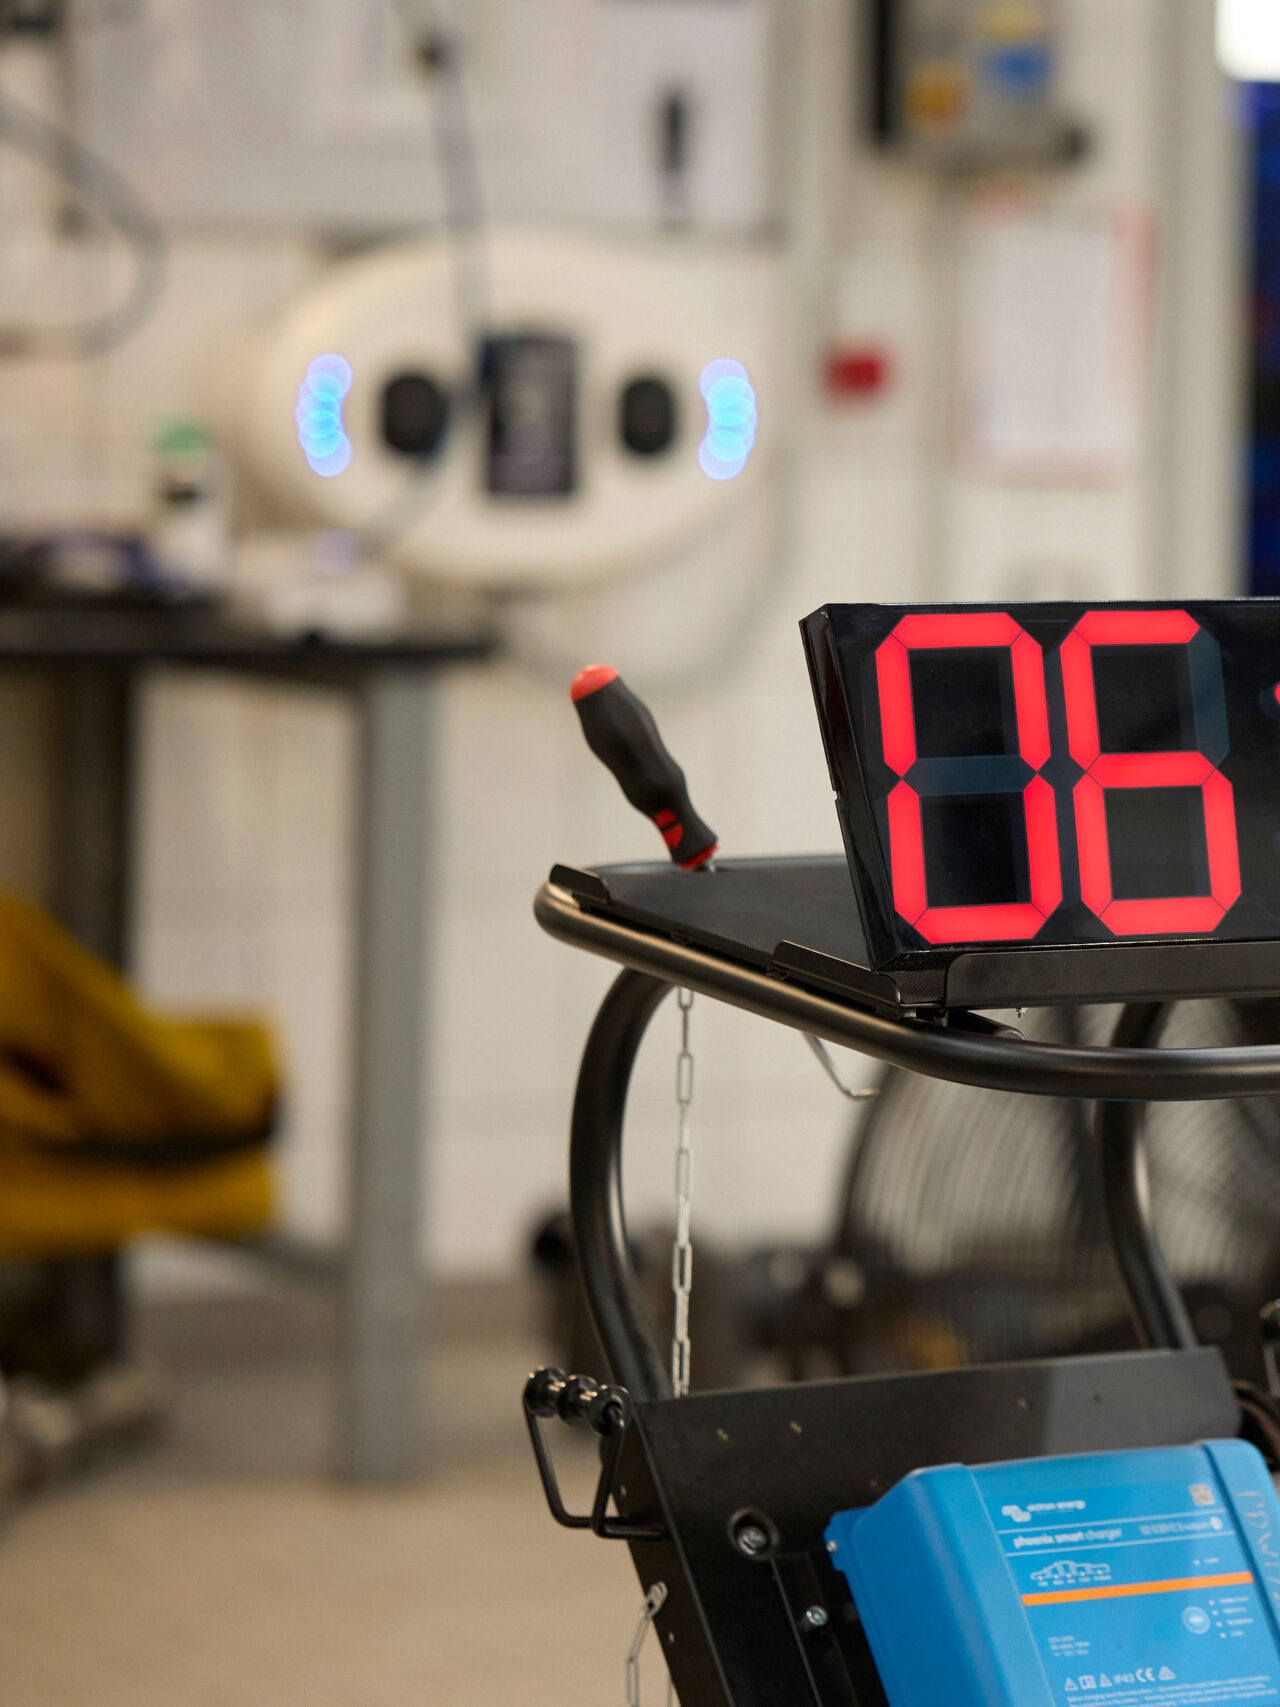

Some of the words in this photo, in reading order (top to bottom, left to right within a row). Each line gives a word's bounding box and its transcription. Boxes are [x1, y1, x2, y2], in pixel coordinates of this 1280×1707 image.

[1013, 1533, 1055, 1550] phoenix
[1054, 1530, 1085, 1545] smart
[1084, 1527, 1122, 1542] charger
